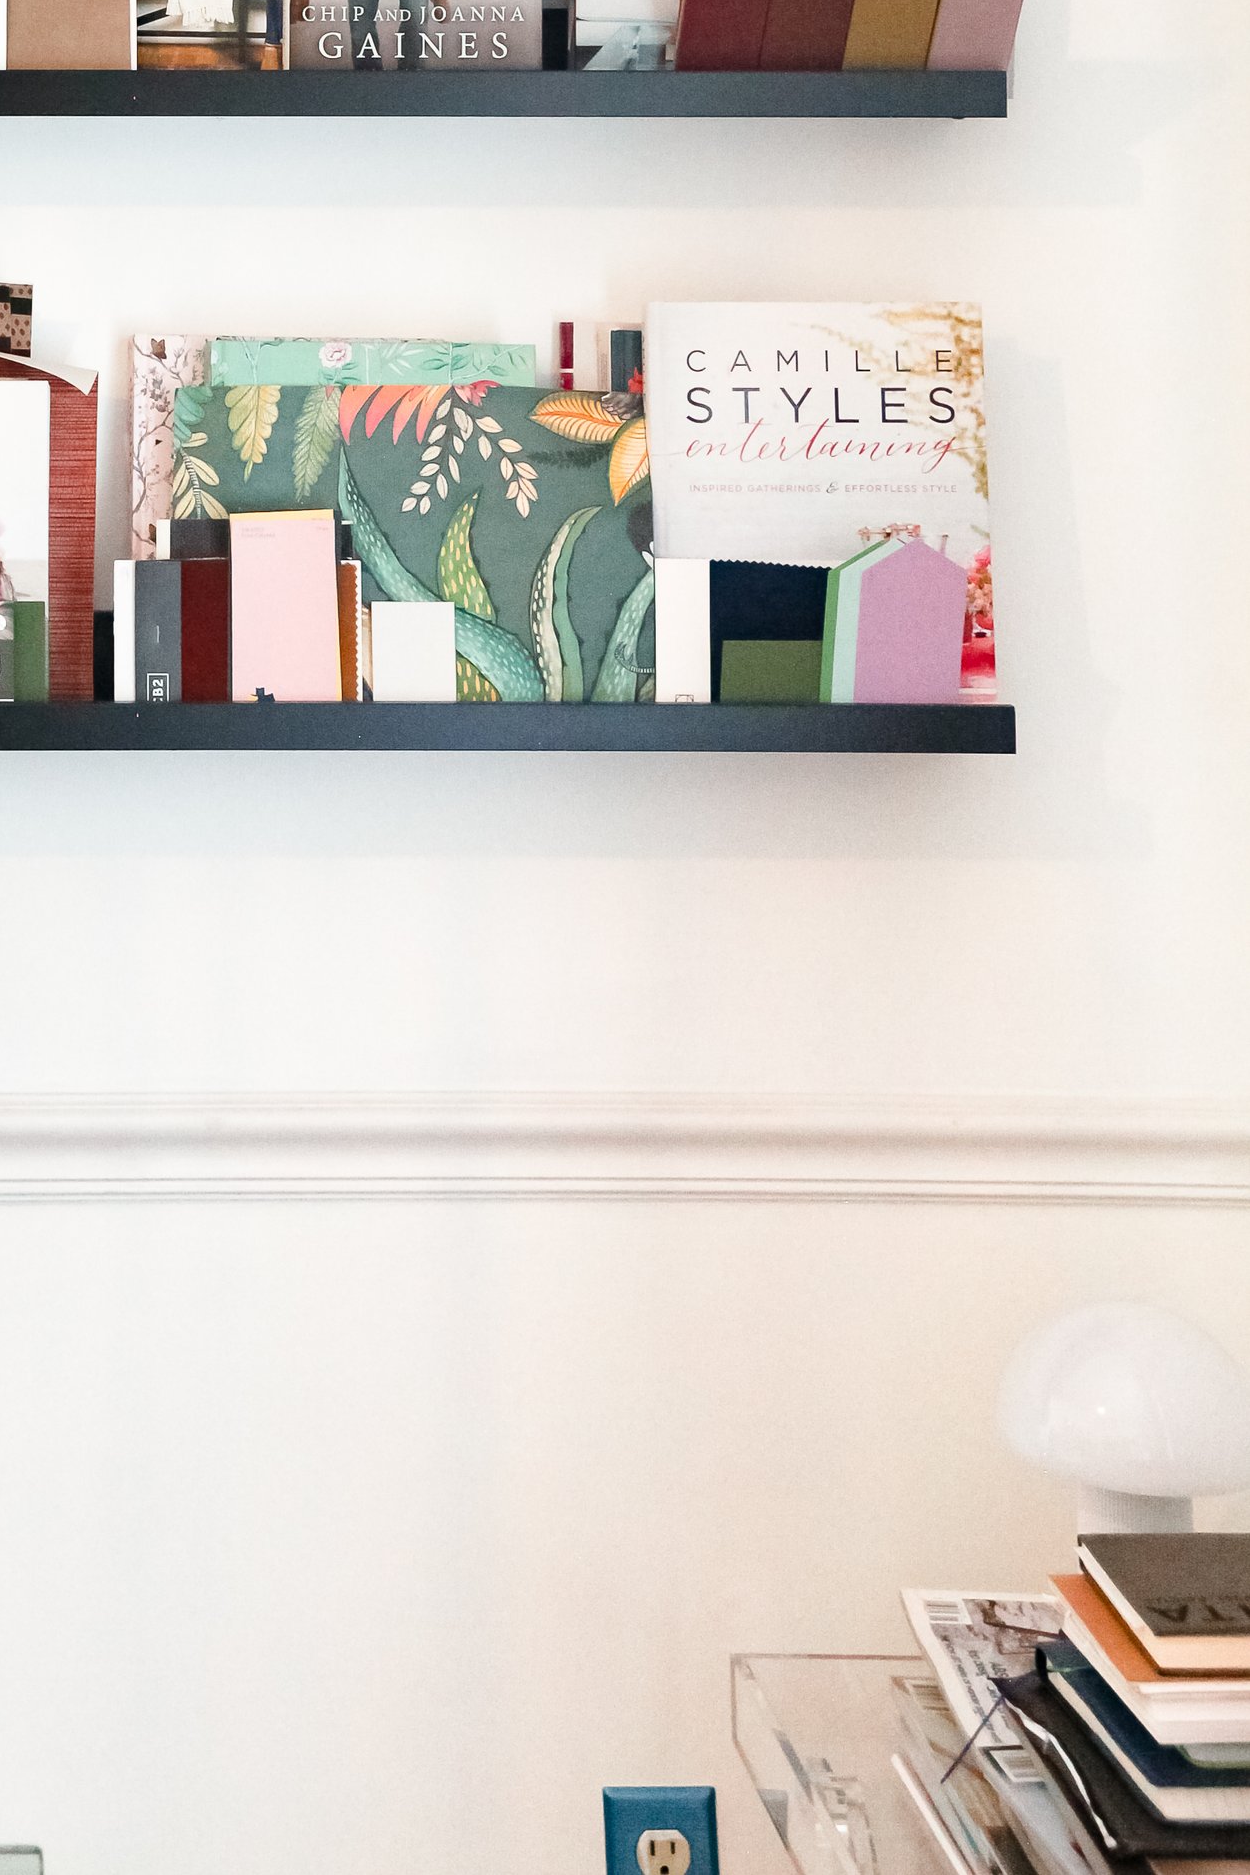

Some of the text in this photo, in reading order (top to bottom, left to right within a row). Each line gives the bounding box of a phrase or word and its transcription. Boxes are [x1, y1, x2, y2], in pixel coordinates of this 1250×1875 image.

[302, 6, 525, 25] CHIP AND JOANNA
[318, 31, 509, 60] GAINES
[686, 349, 953, 373] CAMILLE
[686, 386, 956, 424] STYLES
[686, 418, 962, 474] entertaining
[689, 483, 743, 493] INSPIRED
[747, 483, 821, 493] GATHERINGS
[844, 483, 918, 493] EFFORTLESS
[922, 484, 958, 493] STYLE
